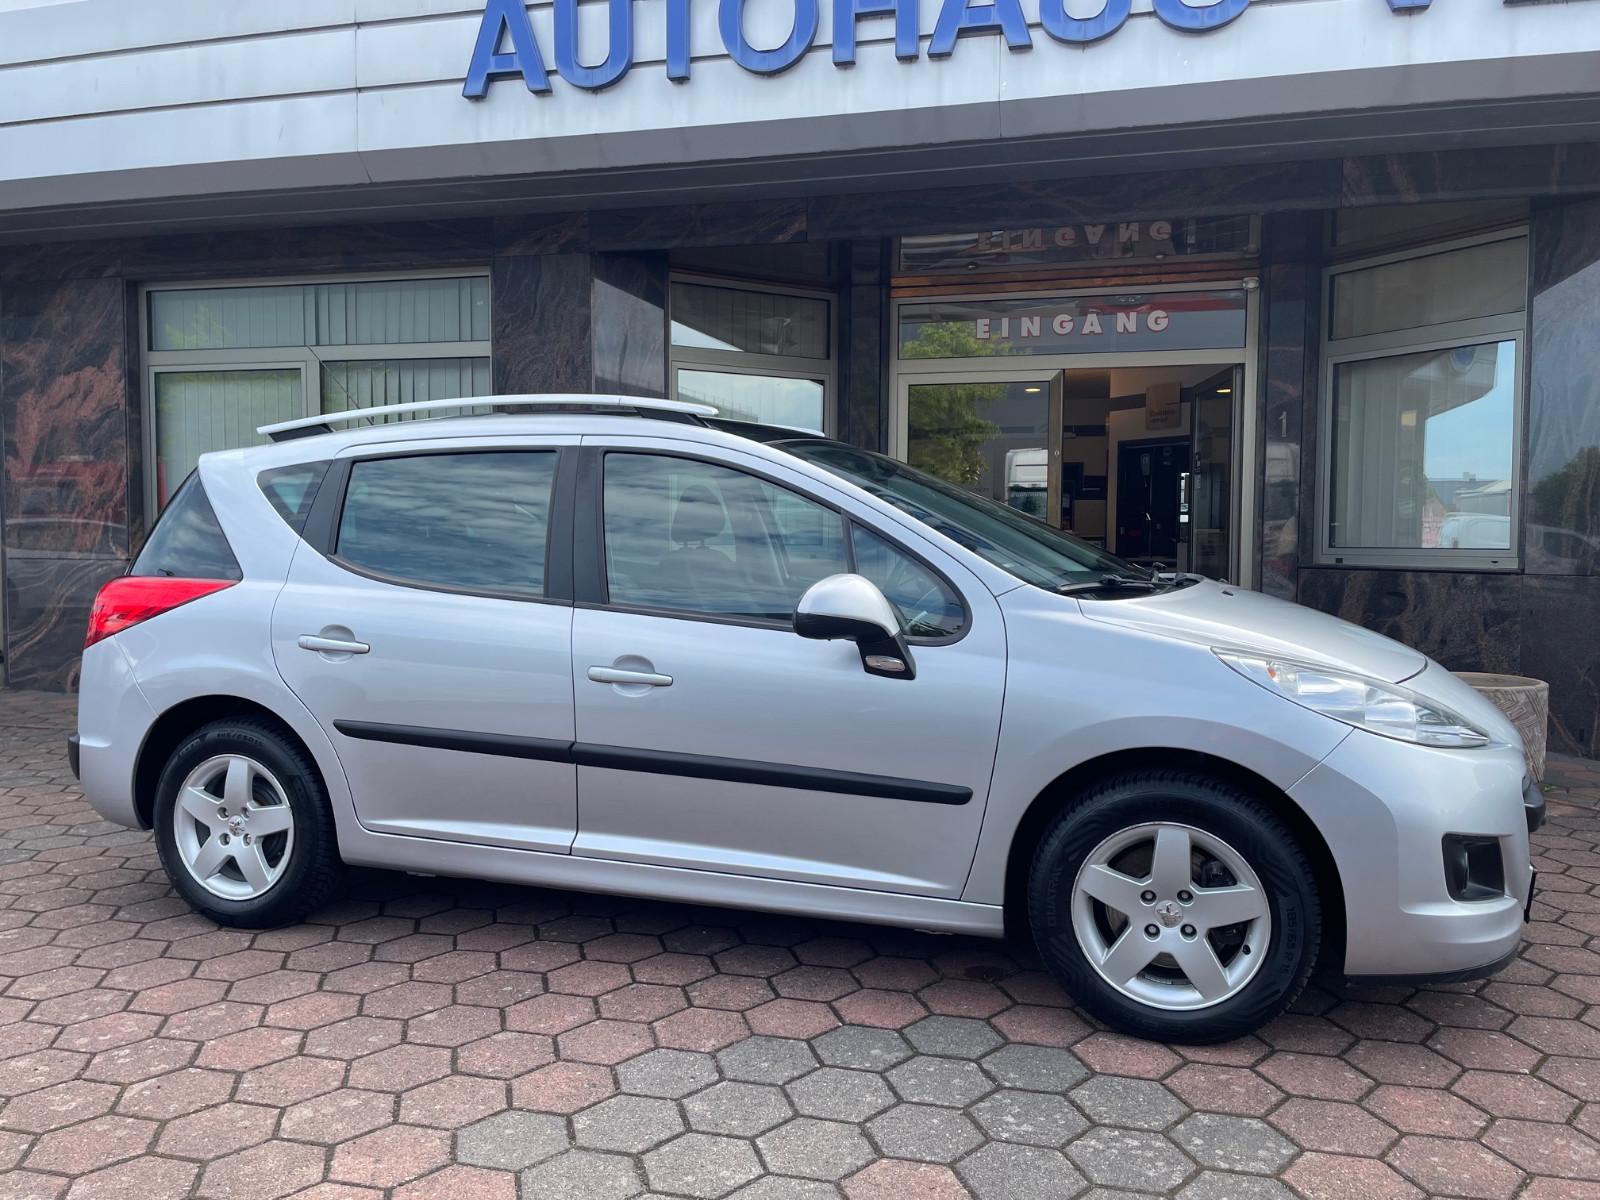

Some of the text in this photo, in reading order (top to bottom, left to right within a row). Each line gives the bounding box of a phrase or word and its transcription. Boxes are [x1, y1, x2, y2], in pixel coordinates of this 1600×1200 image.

[462, 0, 1251, 99] AUTOHA
[976, 309, 1169, 340] EINGANG
[1279, 411, 1287, 438] 1
